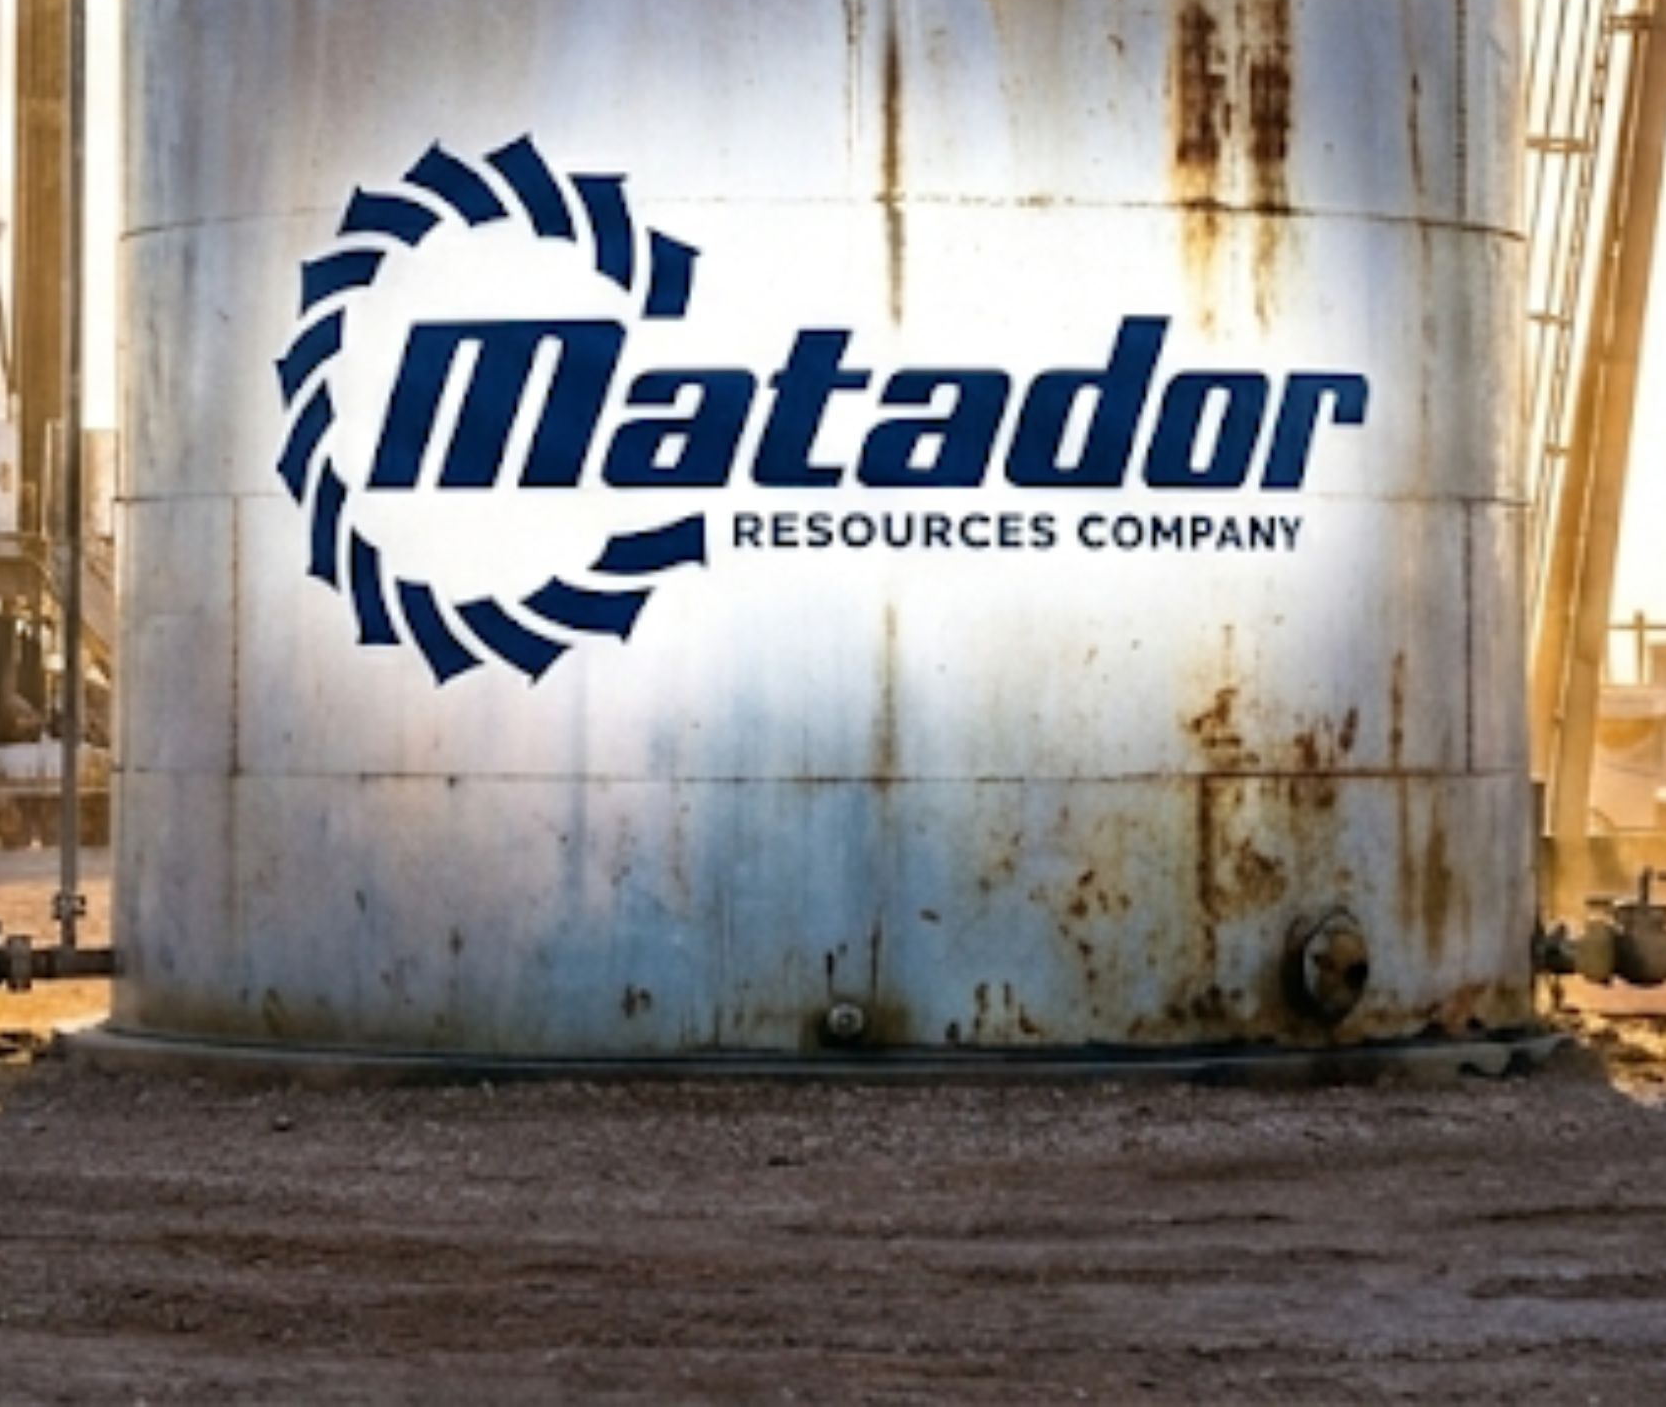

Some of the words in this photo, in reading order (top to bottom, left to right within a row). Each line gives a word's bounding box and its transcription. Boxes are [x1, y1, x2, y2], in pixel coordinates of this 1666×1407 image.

[364, 317, 1371, 491] Matador
[731, 513, 1057, 550] RESOURCES
[1076, 514, 1303, 550] COMPANY
